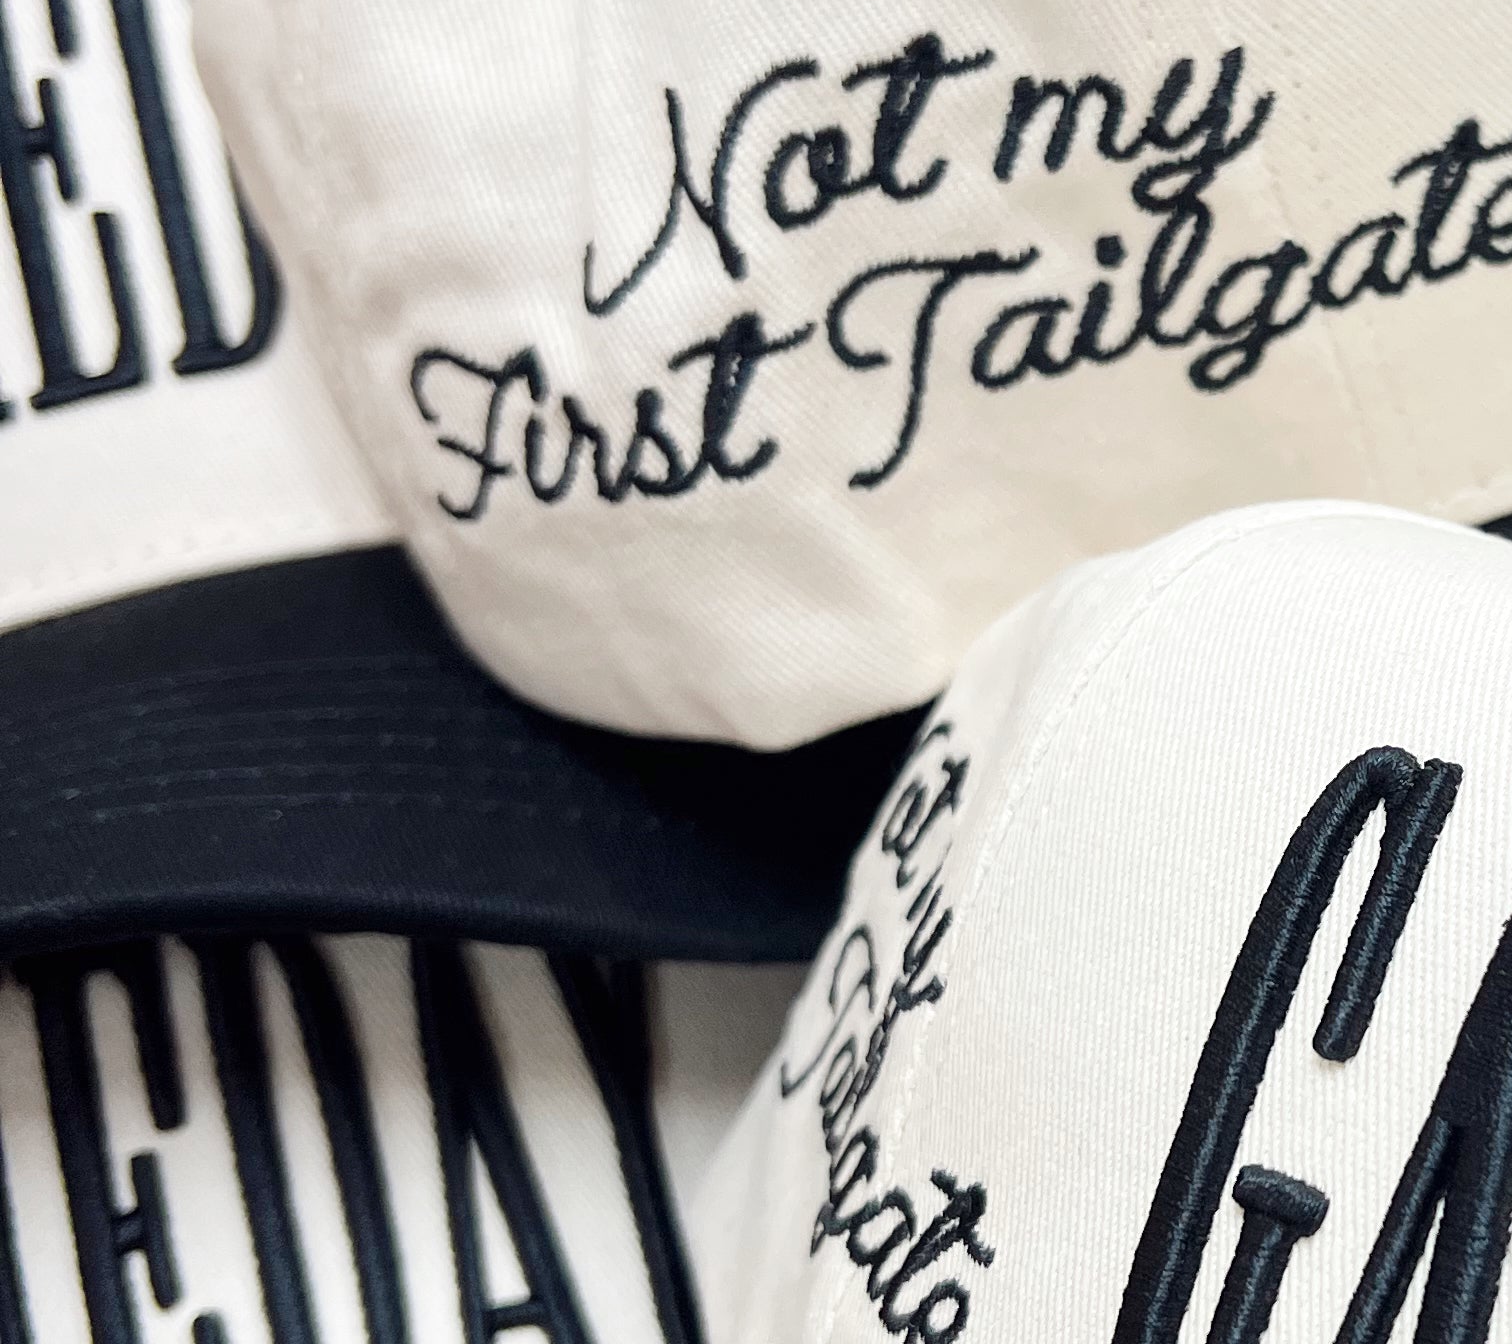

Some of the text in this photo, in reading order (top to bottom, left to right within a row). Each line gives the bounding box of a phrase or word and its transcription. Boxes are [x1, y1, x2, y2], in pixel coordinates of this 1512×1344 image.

[584, 31, 1277, 314] Not my
[409, 311, 816, 520] First
